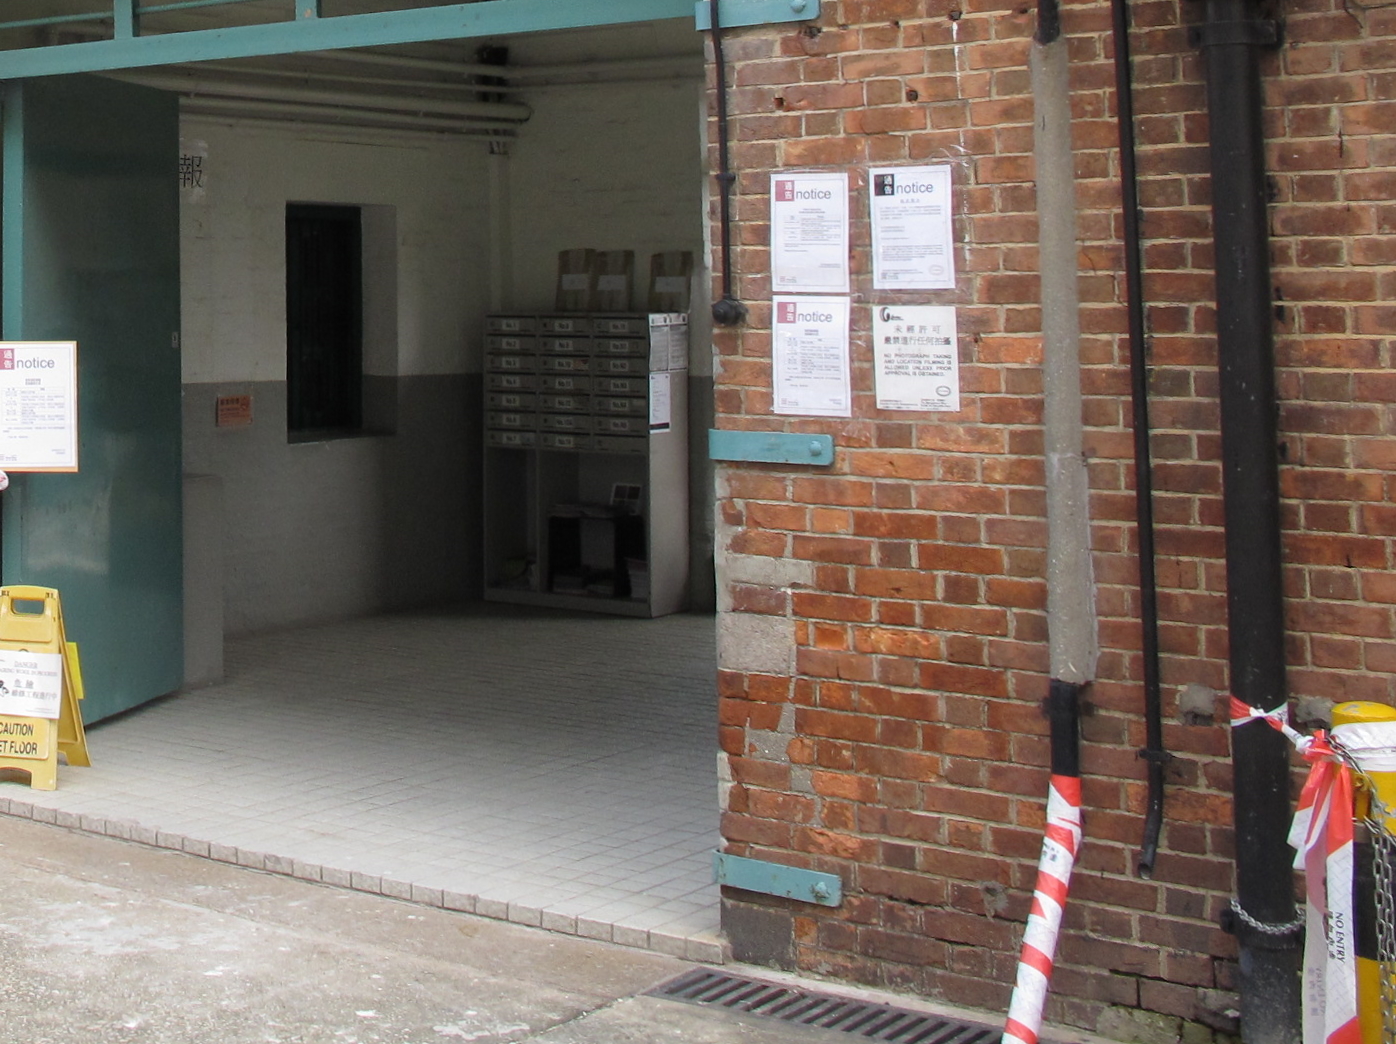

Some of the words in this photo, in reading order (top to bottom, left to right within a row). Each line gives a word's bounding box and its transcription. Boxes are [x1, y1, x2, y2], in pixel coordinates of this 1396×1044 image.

[795, 188, 832, 200] notice
[896, 181, 934, 194] notice
[797, 311, 833, 322] notice
[16, 357, 55, 369] notice
[9, 741, 38, 755] FLOOR
[1335, 911, 1344, 929] NO
[1335, 931, 1345, 963] ENTRY
